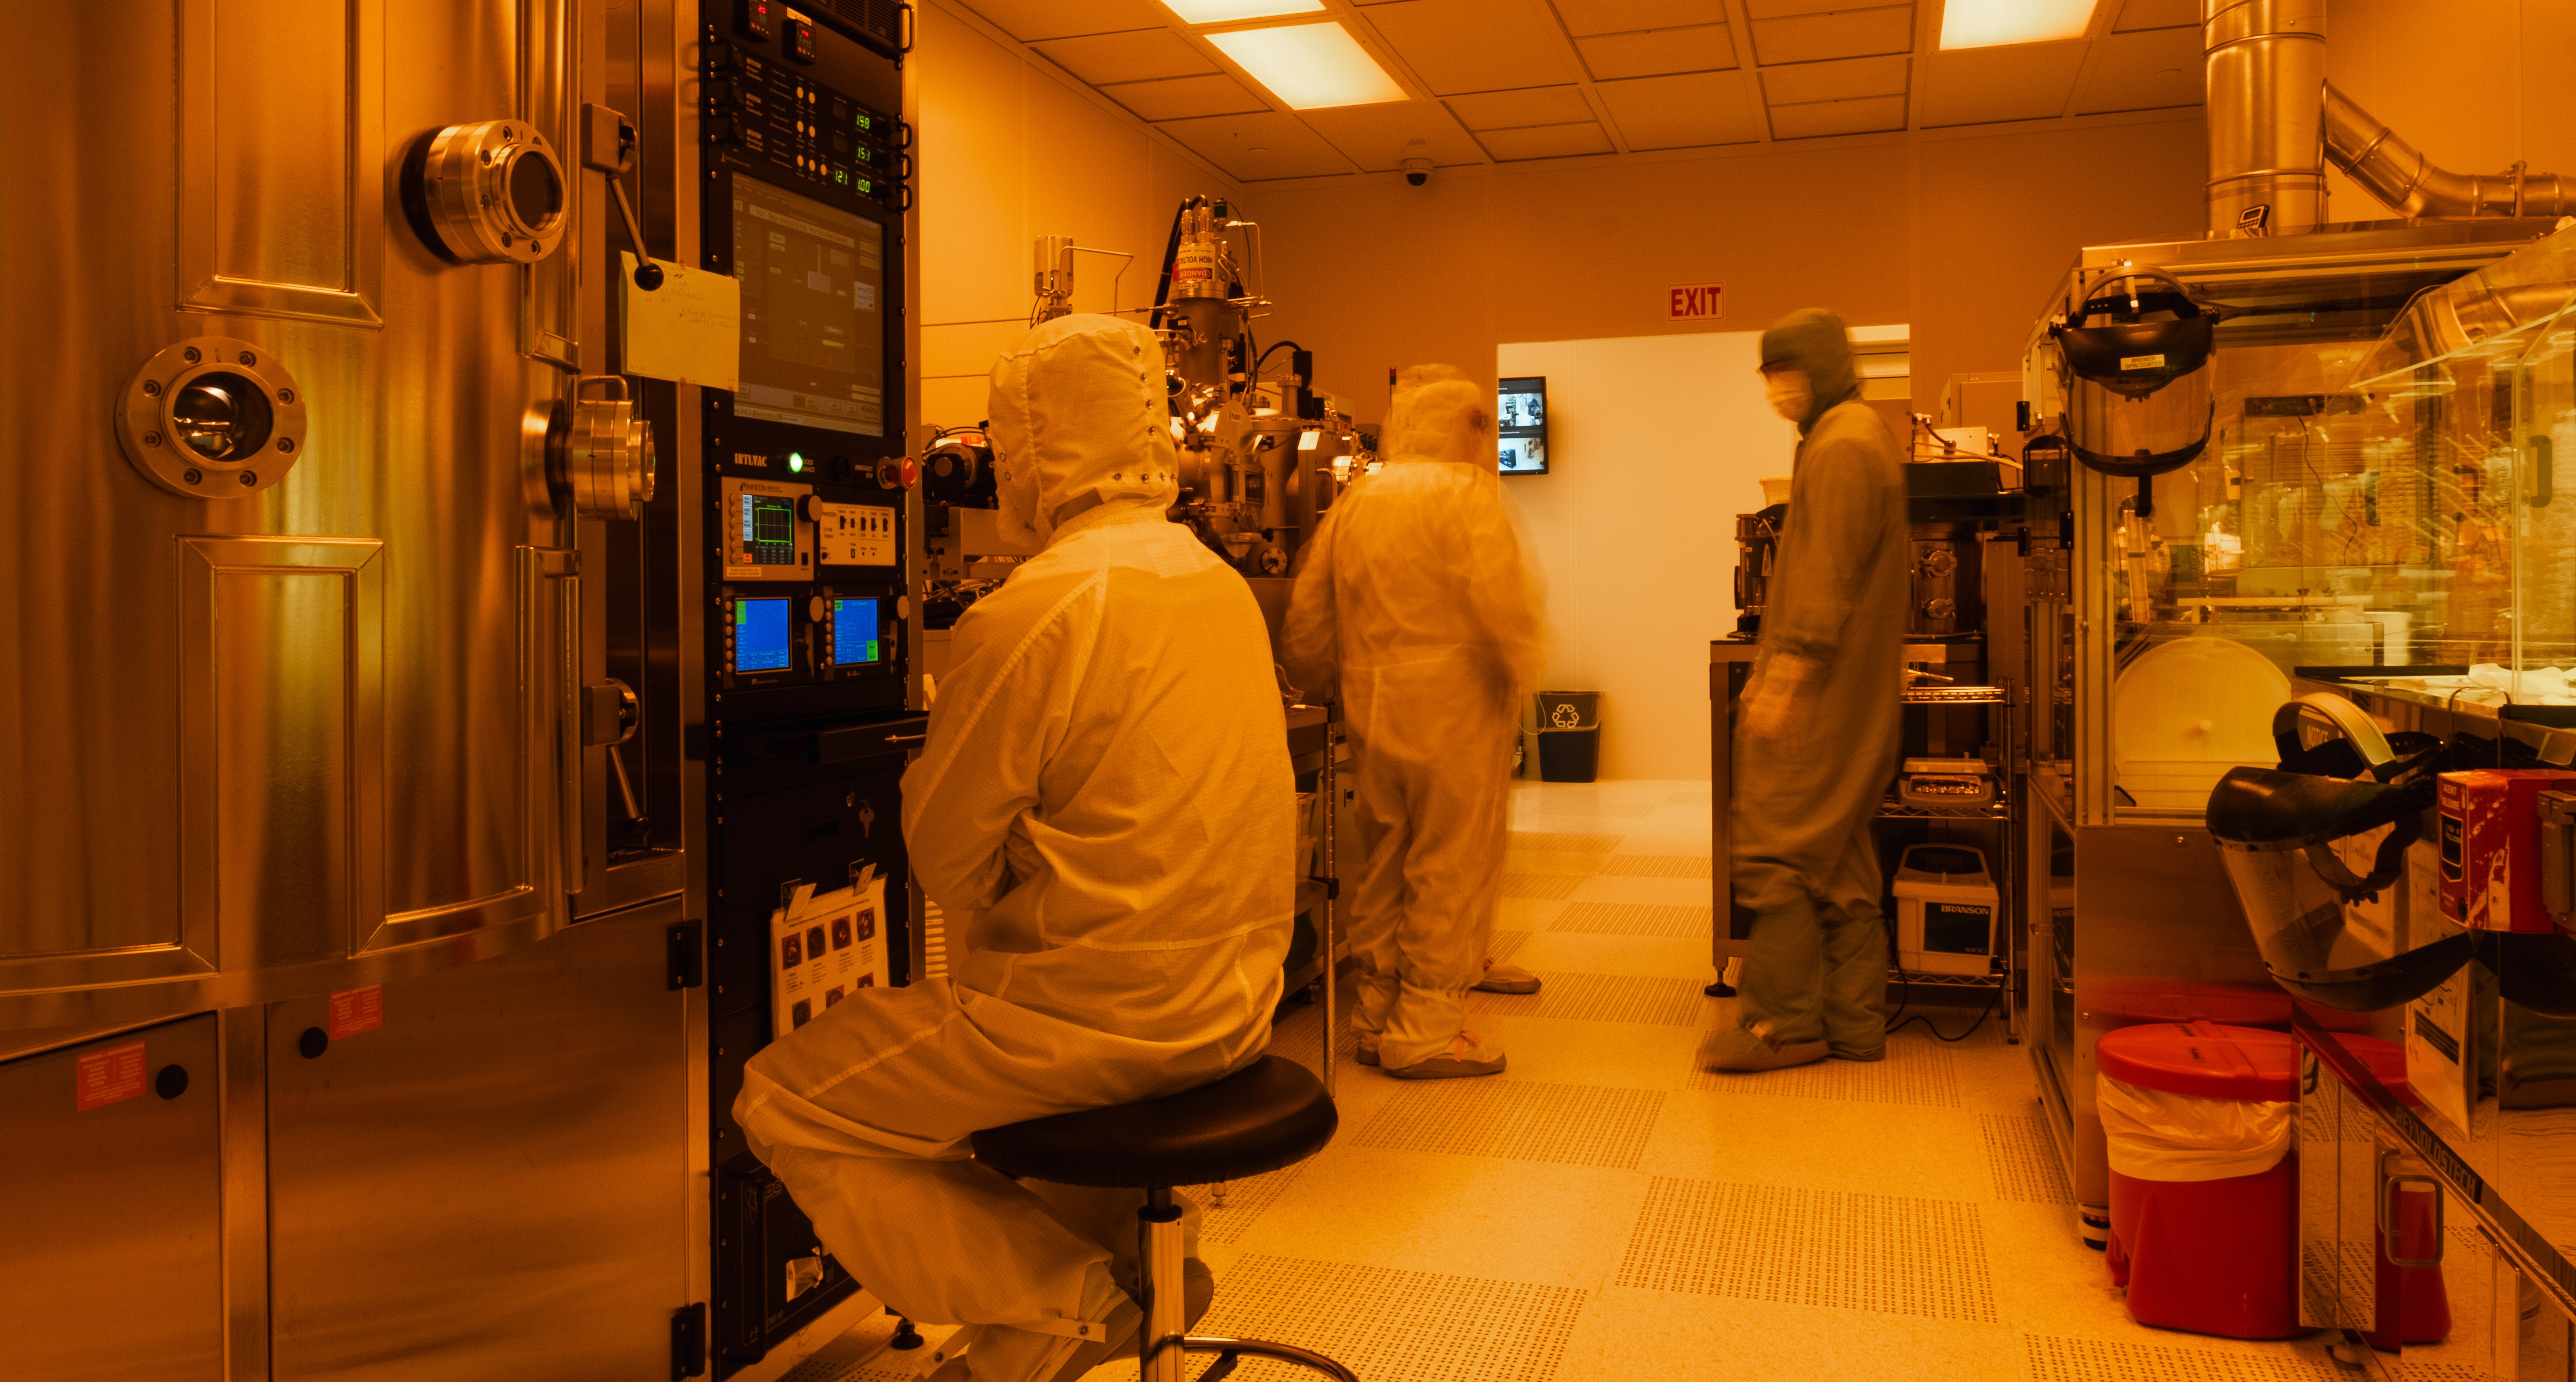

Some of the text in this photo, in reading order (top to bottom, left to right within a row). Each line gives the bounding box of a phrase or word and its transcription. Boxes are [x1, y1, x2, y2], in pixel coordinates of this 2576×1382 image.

[1671, 286, 1720, 317] EXIT
[734, 453, 767, 467] INTLVAC
[2307, 725, 2329, 746] NOTICE
[2443, 783, 2457, 796] AGENT
[2442, 796, 2460, 811] RELEASE
[1941, 905, 1989, 915] BRANSON
[2396, 1106, 2475, 1196] REYNOLDSTECH
